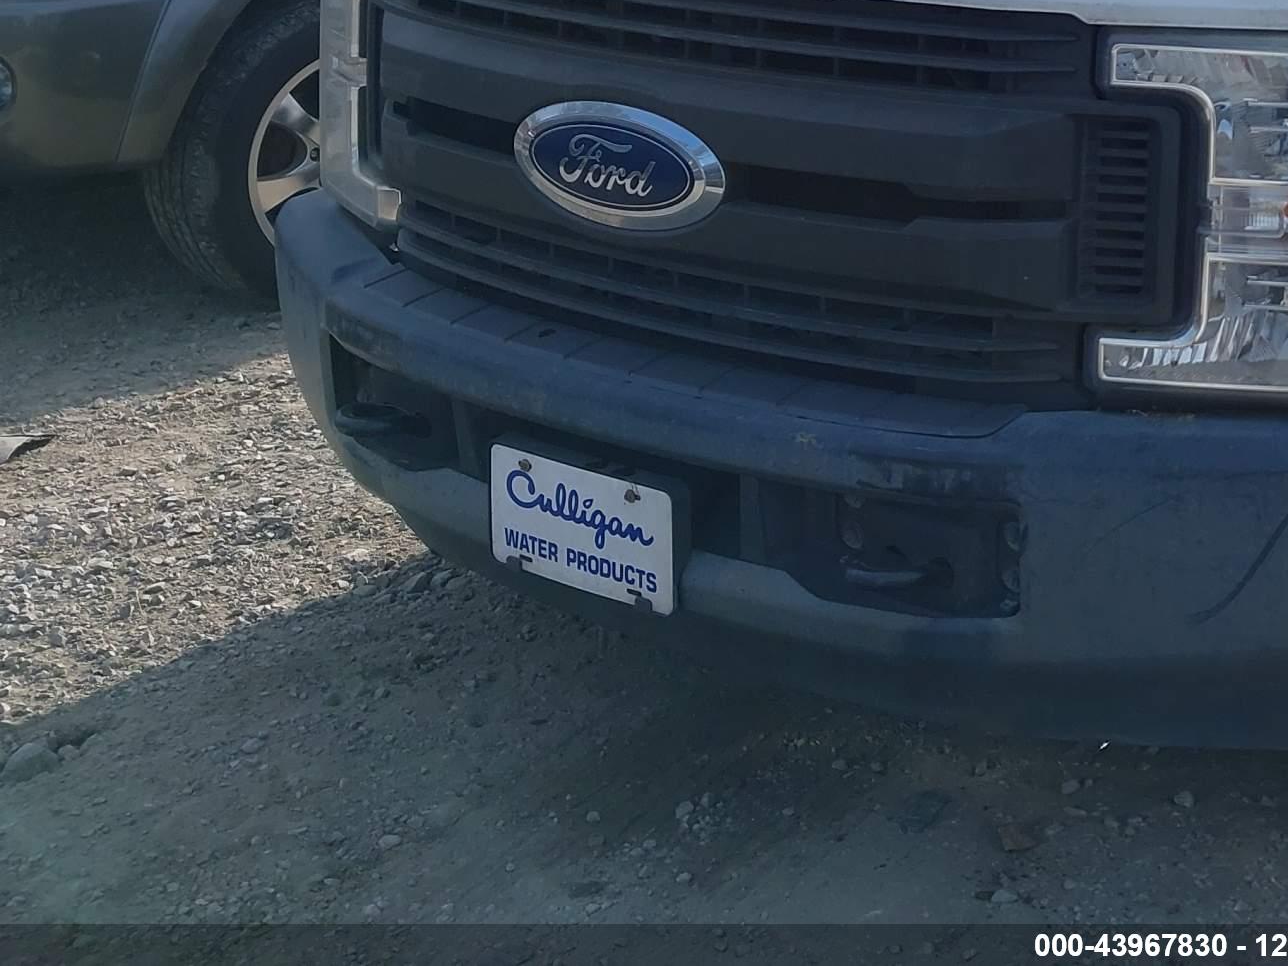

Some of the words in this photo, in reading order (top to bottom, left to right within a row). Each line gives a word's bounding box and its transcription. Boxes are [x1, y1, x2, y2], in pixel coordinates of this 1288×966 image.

[559, 133, 656, 197] Ford
[506, 470, 654, 549] Culligan
[504, 527, 559, 563] WATER
[566, 547, 658, 594] PRODUCTS
